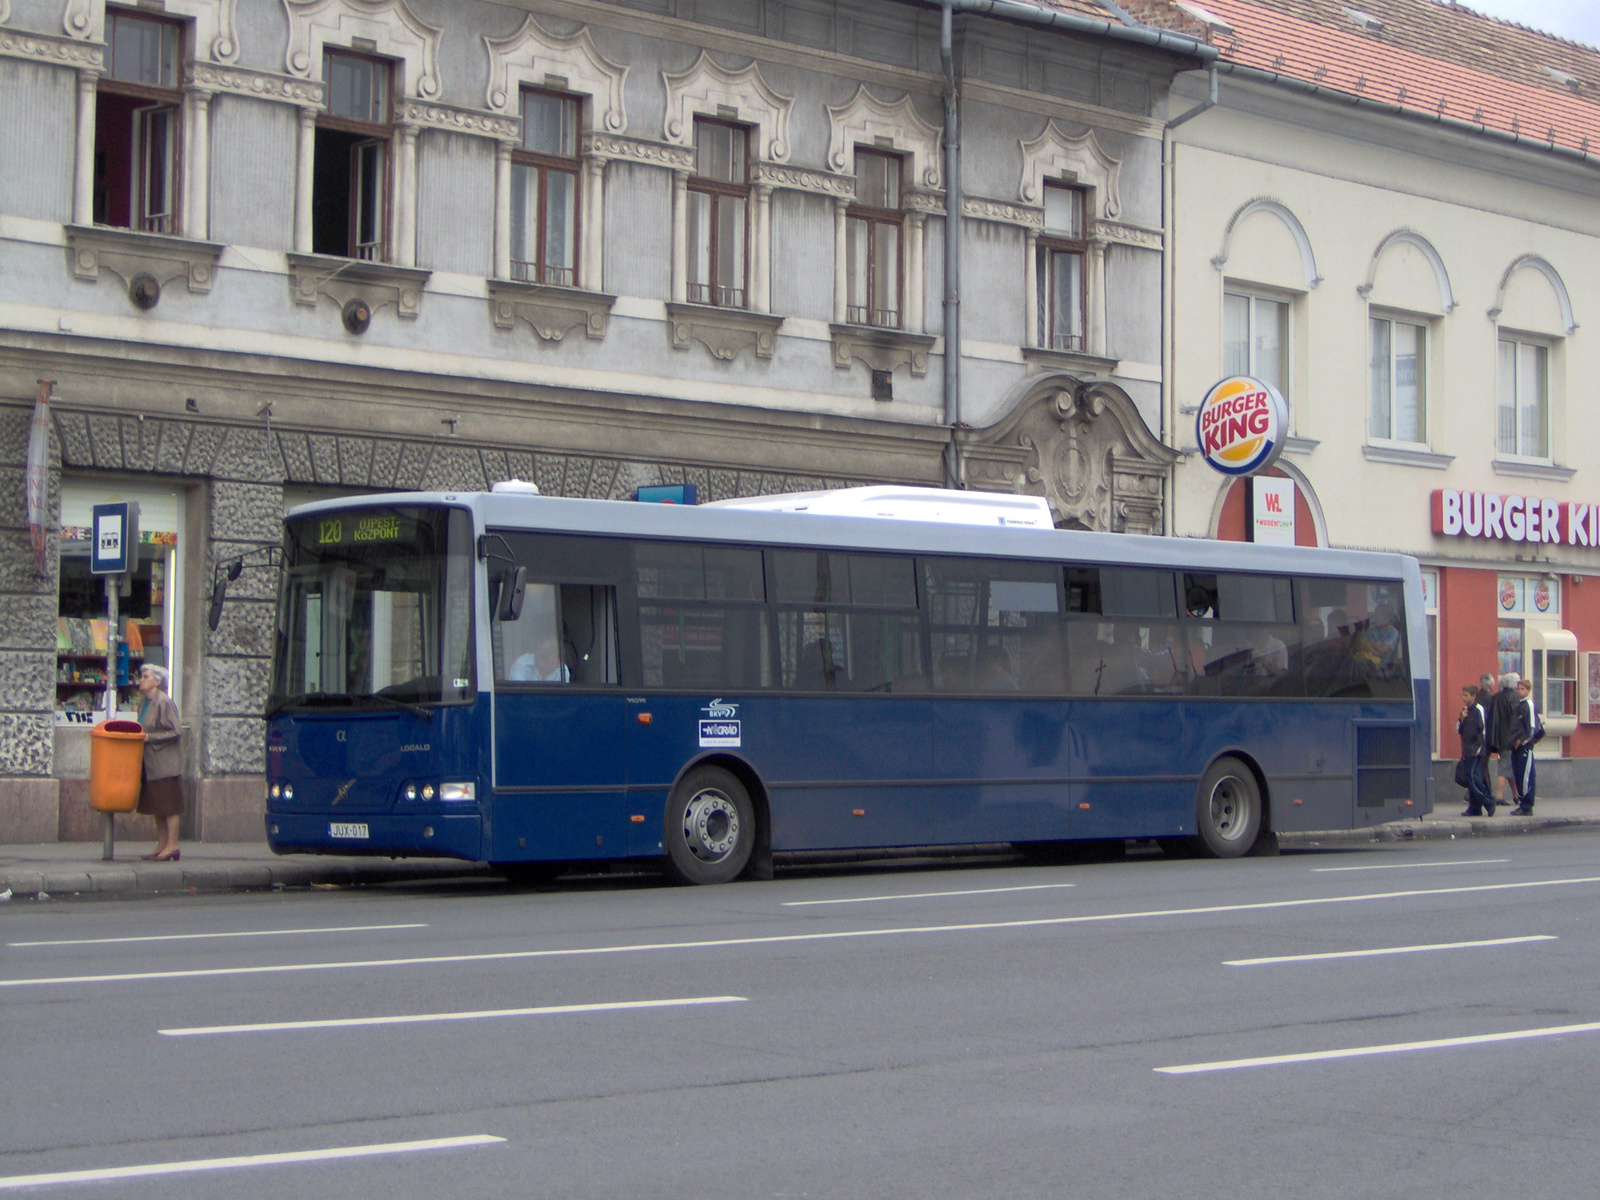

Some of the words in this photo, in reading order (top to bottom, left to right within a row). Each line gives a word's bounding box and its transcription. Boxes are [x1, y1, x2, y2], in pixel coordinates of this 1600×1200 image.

[1202, 392, 1267, 432] BURGER
[1205, 408, 1270, 457] KING
[1265, 493, 1282, 512] WL
[1441, 488, 1561, 544] BURGER
[1568, 501, 1600, 547] KI
[319, 520, 342, 544] 120
[332, 824, 367, 837] JUX-017
